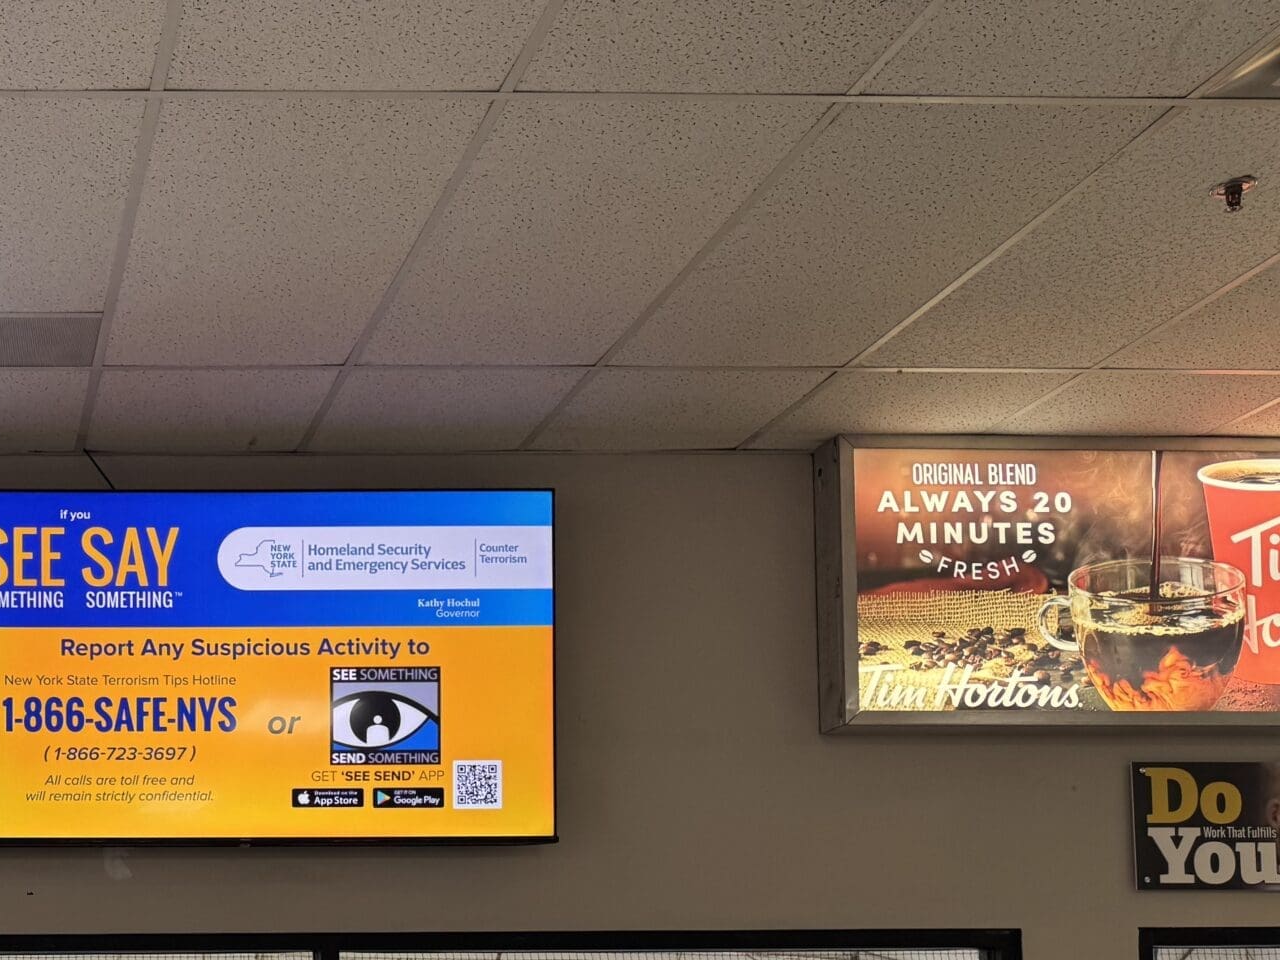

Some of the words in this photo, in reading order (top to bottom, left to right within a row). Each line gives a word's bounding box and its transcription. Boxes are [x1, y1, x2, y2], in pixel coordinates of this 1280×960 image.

[912, 463, 984, 486] ORIGINAL
[988, 463, 1037, 486] BLEND
[877, 490, 1018, 513] ALWAYS
[1033, 490, 1072, 513] 20
[59, 509, 69, 520] if
[69, 511, 91, 522] you
[896, 522, 1056, 545] MINUTES
[270, 544, 291, 552] NEW
[308, 543, 375, 557] Homeland
[377, 543, 431, 559] Security
[479, 543, 519, 553] Counter
[81, 526, 180, 587] SAY
[270, 552, 295, 560] YORK
[479, 555, 527, 565] Terrorism
[270, 560, 297, 568] STATE
[308, 558, 332, 571] and
[335, 558, 408, 574] Emergency
[411, 558, 466, 571] Services
[936, 555, 1020, 581] FRESH
[85, 591, 174, 609] SOMETHING
[417, 598, 445, 609] Kathy
[447, 598, 480, 608] Hochul
[436, 609, 481, 618] Governor
[60, 638, 135, 660] Report
[141, 638, 184, 660] Any
[191, 638, 311, 660] Suspicious
[317, 637, 401, 659] Activity
[407, 638, 430, 656] to
[4, 674, 32, 686] New
[36, 674, 63, 686] York
[66, 674, 98, 686] State
[102, 674, 159, 686] Terrorism
[163, 674, 189, 688] Tips
[192, 674, 236, 686] Hotline
[332, 668, 357, 681] SEE
[360, 668, 438, 681] SOMETHING
[859, 663, 927, 709] Tim
[2, 696, 238, 733] 1-866-SAFE-NYS
[267, 714, 301, 735] or
[331, 753, 366, 764] SEND
[367, 753, 439, 764] SOMETHING
[44, 774, 61, 786] All
[64, 774, 92, 786] calls
[96, 777, 117, 786] are
[120, 774, 138, 786] toll
[141, 774, 167, 786] free
[170, 774, 195, 786] and
[311, 771, 337, 782] GET
[418, 770, 445, 781] APP
[25, 790, 45, 802] will
[49, 791, 92, 802] remain
[95, 790, 136, 804] strictly
[138, 790, 214, 802] confidential.
[314, 796, 334, 807] App
[334, 796, 359, 805] Store
[393, 795, 423, 806] Google
[423, 795, 441, 806] Play
[1144, 767, 1242, 825] Do
[1203, 826, 1226, 839] Work
[1226, 826, 1246, 839] That
[1247, 826, 1277, 839] Fulfills
[1147, 827, 1280, 885] You
